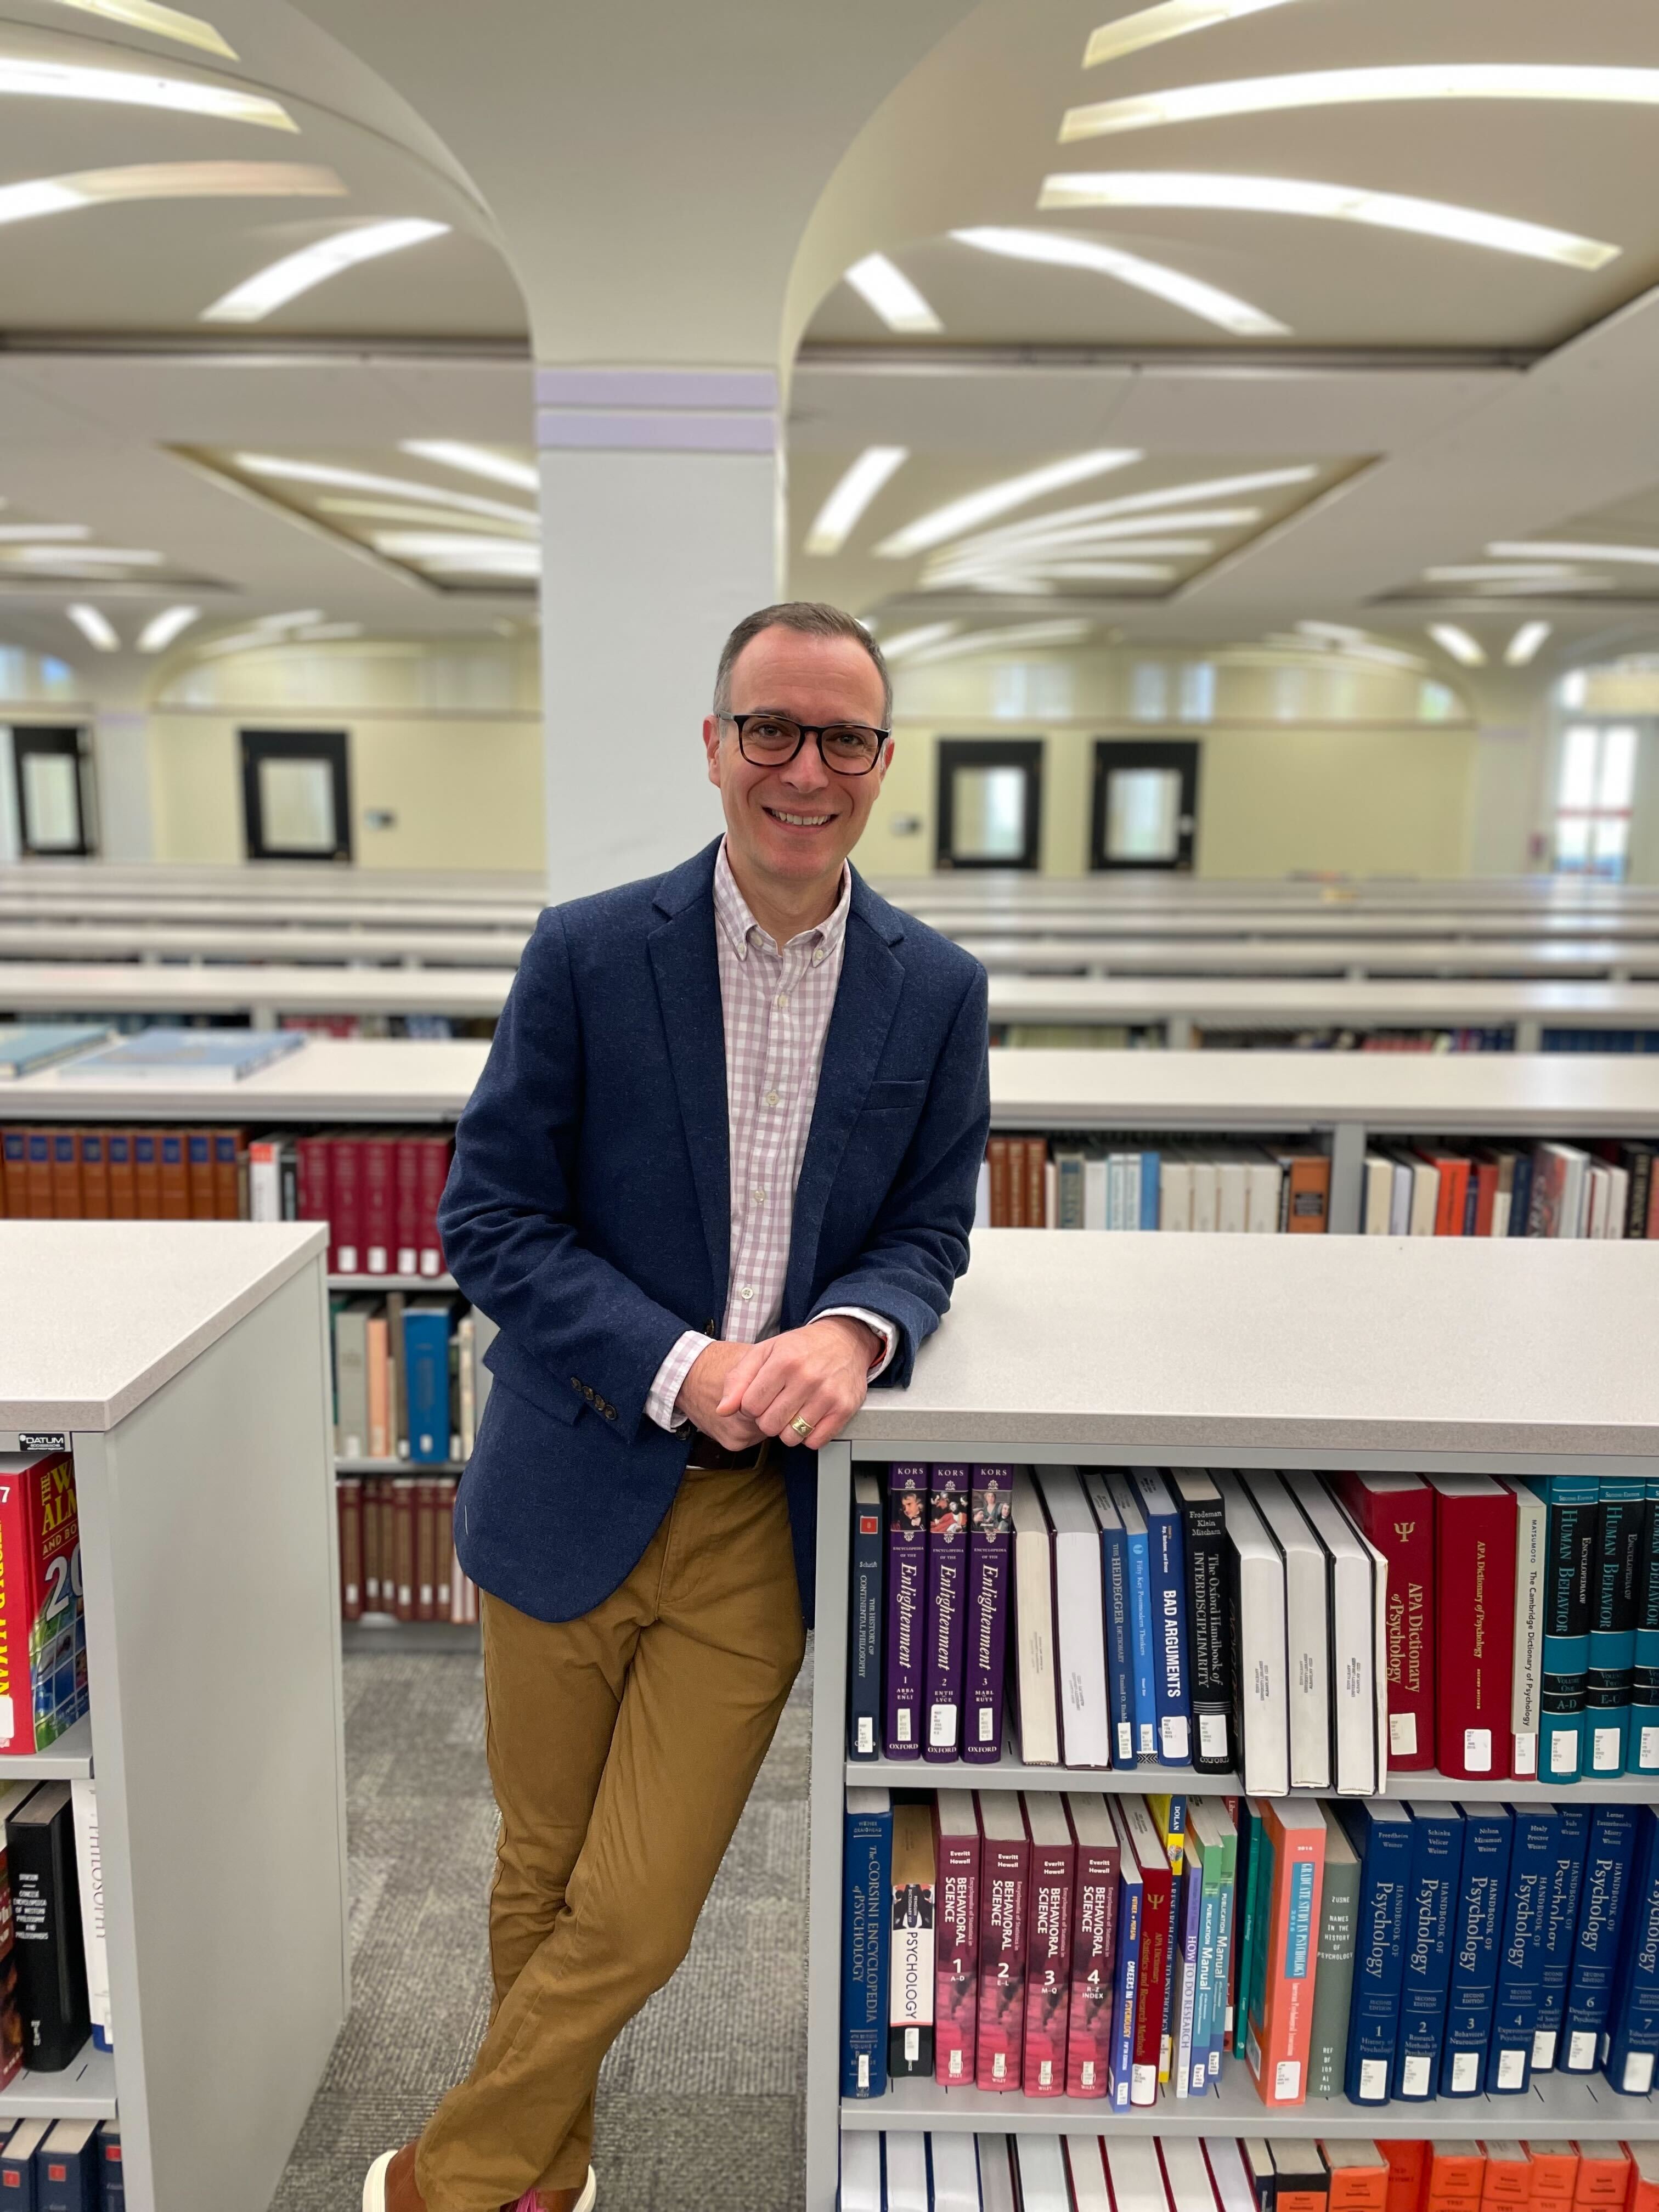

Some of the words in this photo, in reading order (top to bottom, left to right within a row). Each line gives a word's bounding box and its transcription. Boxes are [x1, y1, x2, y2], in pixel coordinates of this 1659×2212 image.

[41, 1473, 51, 1506] THE
[43, 1536, 61, 1556] AND
[64, 1523, 78, 1538] BO
[1477, 1541, 1486, 1560] APA
[1560, 1510, 1578, 1560] HUMAN
[1605, 1506, 1623, 1555] HUMAN
[1207, 1554, 1219, 1575] The
[1475, 1562, 1485, 1603] Dictionary
[859, 1575, 867, 1628] CONTINENTAL
[1111, 1557, 1124, 1624] HEIDEGGER
[1163, 1590, 1178, 1616] BAD
[1209, 1578, 1221, 1613] Oxford
[1391, 1594, 1401, 1603] of
[1409, 1583, 1423, 1612] APA
[1475, 1605, 1485, 1614] of
[1527, 1588, 1537, 1630] Cambridge
[1556, 1567, 1575, 1632] BEHAVIOR
[1600, 1564, 1619, 1628] BEHAVIOR
[897, 1562, 917, 1668] Enlightenment
[936, 1564, 956, 1671] Enlightenment
[978, 1564, 998, 1671] Enlightenment
[1194, 1551, 1209, 1688] INTERDISCIPLINARITY
[868, 1646, 874, 1655] OF
[1210, 1615, 1223, 1668] Handbook
[1387, 1604, 1406, 1684] Psychology
[1405, 1615, 1423, 1692] Dictionary
[1474, 1615, 1485, 1659] Psychology
[1525, 1633, 1535, 1671] Dictionary
[1165, 1619, 1181, 1698] ARGUMENTS
[1526, 1673, 1534, 1681] of
[1210, 1674, 1223, 1686] of
[1523, 1684, 1533, 1726] Psychology
[852, 1886, 862, 1895] of
[868, 1861, 880, 1916] CORSINI
[945, 1877, 955, 1922] SCIENCE
[1299, 1863, 1313, 1899] GRADUATE
[956, 1877, 967, 1946] BEHAVIORAL
[991, 1880, 1003, 1926] SCIENCE
[1002, 1881, 1014, 1950] BEHAVIORAL
[1037, 1887, 1049, 1934] SCIENCE
[1048, 1888, 1060, 1957] BEHAVIORAL
[1082, 1886, 1094, 1932] SCIENCE
[1092, 1887, 1105, 1957] BEHAVIORAL
[1297, 1901, 1310, 1922] STUDY
[1437, 1882, 1449, 1937] HANDBOOK
[1486, 1880, 1498, 1934] HANDBOOK
[1508, 1874, 1537, 1968] Psychology
[1581, 1859, 1613, 1952] Psychology
[853, 1895, 865, 1983] PSYCHOLOGY
[1297, 1925, 1308, 1933] IN
[1366, 1881, 1393, 1978] Psychology
[1410, 1878, 1439, 1975] Psychology
[1459, 1877, 1488, 1972] Psychology
[1485, 1938, 1492, 1950] OF
[953, 1959, 962, 1973] 1
[1186, 1935, 1197, 1962] HOW
[1200, 1946, 1212, 1990] Manual
[1215, 1936, 1227, 1978] Manual
[1294, 1934, 1307, 1976] PSYCHOLOGY
[1317, 1952, 1353, 1960] PSYCHOLOGY
[1436, 1942, 1444, 1954] OF
[866, 1922, 879, 2023] ENCYCLOPEDIA
[906, 1932, 918, 2019] PSYCHOLOGY
[998, 1963, 1009, 1978] 2
[1045, 1971, 1055, 1985] 3
[1087, 1970, 1099, 1984] 4
[1126, 1961, 1135, 1990] CAREERS
[1184, 1981, 1194, 1997] DO
[1186, 1962, 1195, 1979] TO
[1124, 2000, 1133, 2038] PSYCHOLOGY
[1514, 2015, 1522, 2025] 4
[1545, 1996, 1554, 2006] 5
[1587, 1997, 1595, 2007] 6
[1181, 2000, 1192, 2048] RESEARCH
[1376, 2025, 1382, 2037] 1
[1419, 2022, 1426, 2033] 2
[1466, 2018, 1475, 2029] 3
[1644, 2019, 1652, 2029] 7
